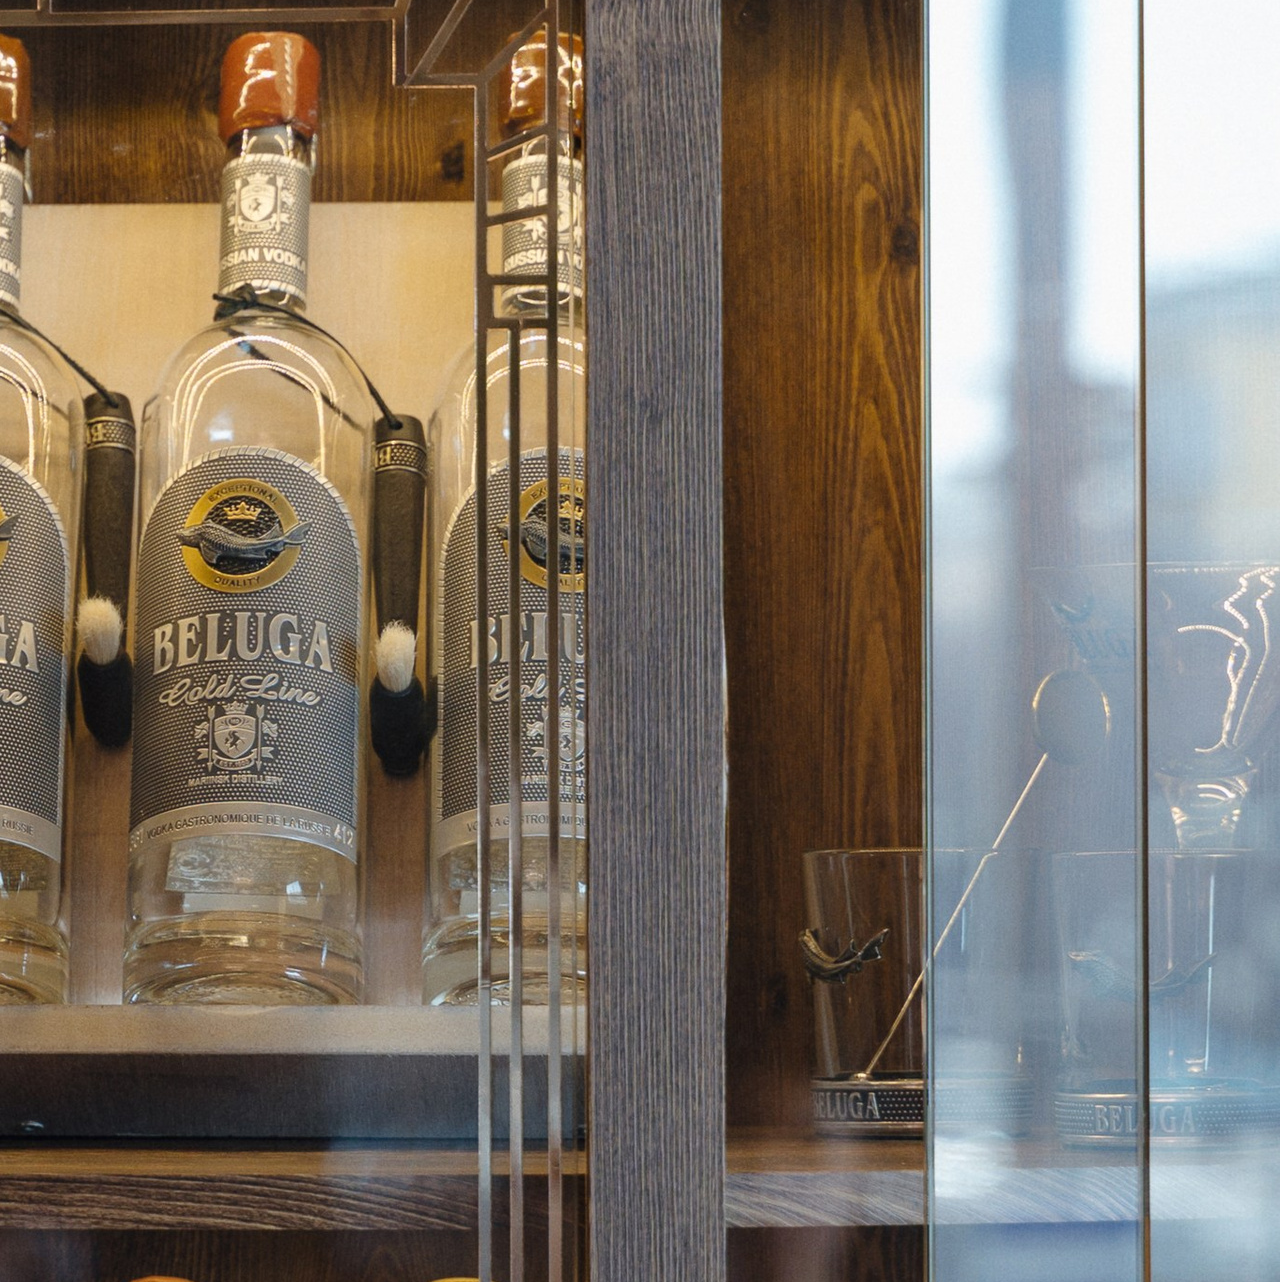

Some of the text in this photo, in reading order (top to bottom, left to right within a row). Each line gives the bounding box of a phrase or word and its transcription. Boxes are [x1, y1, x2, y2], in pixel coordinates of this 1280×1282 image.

[207, 484, 278, 505] EXCEPTIONAL
[214, 576, 261, 587] QUALITY
[152, 612, 334, 676] BELUGA
[159, 673, 320, 707] Gold Line
[2, 819, 35, 835] RUSSIE
[147, 813, 332, 839] VODKA GASTRONOMIQUE DE LA RUSSIE
[1095, 1105, 1195, 1133] BELGA
